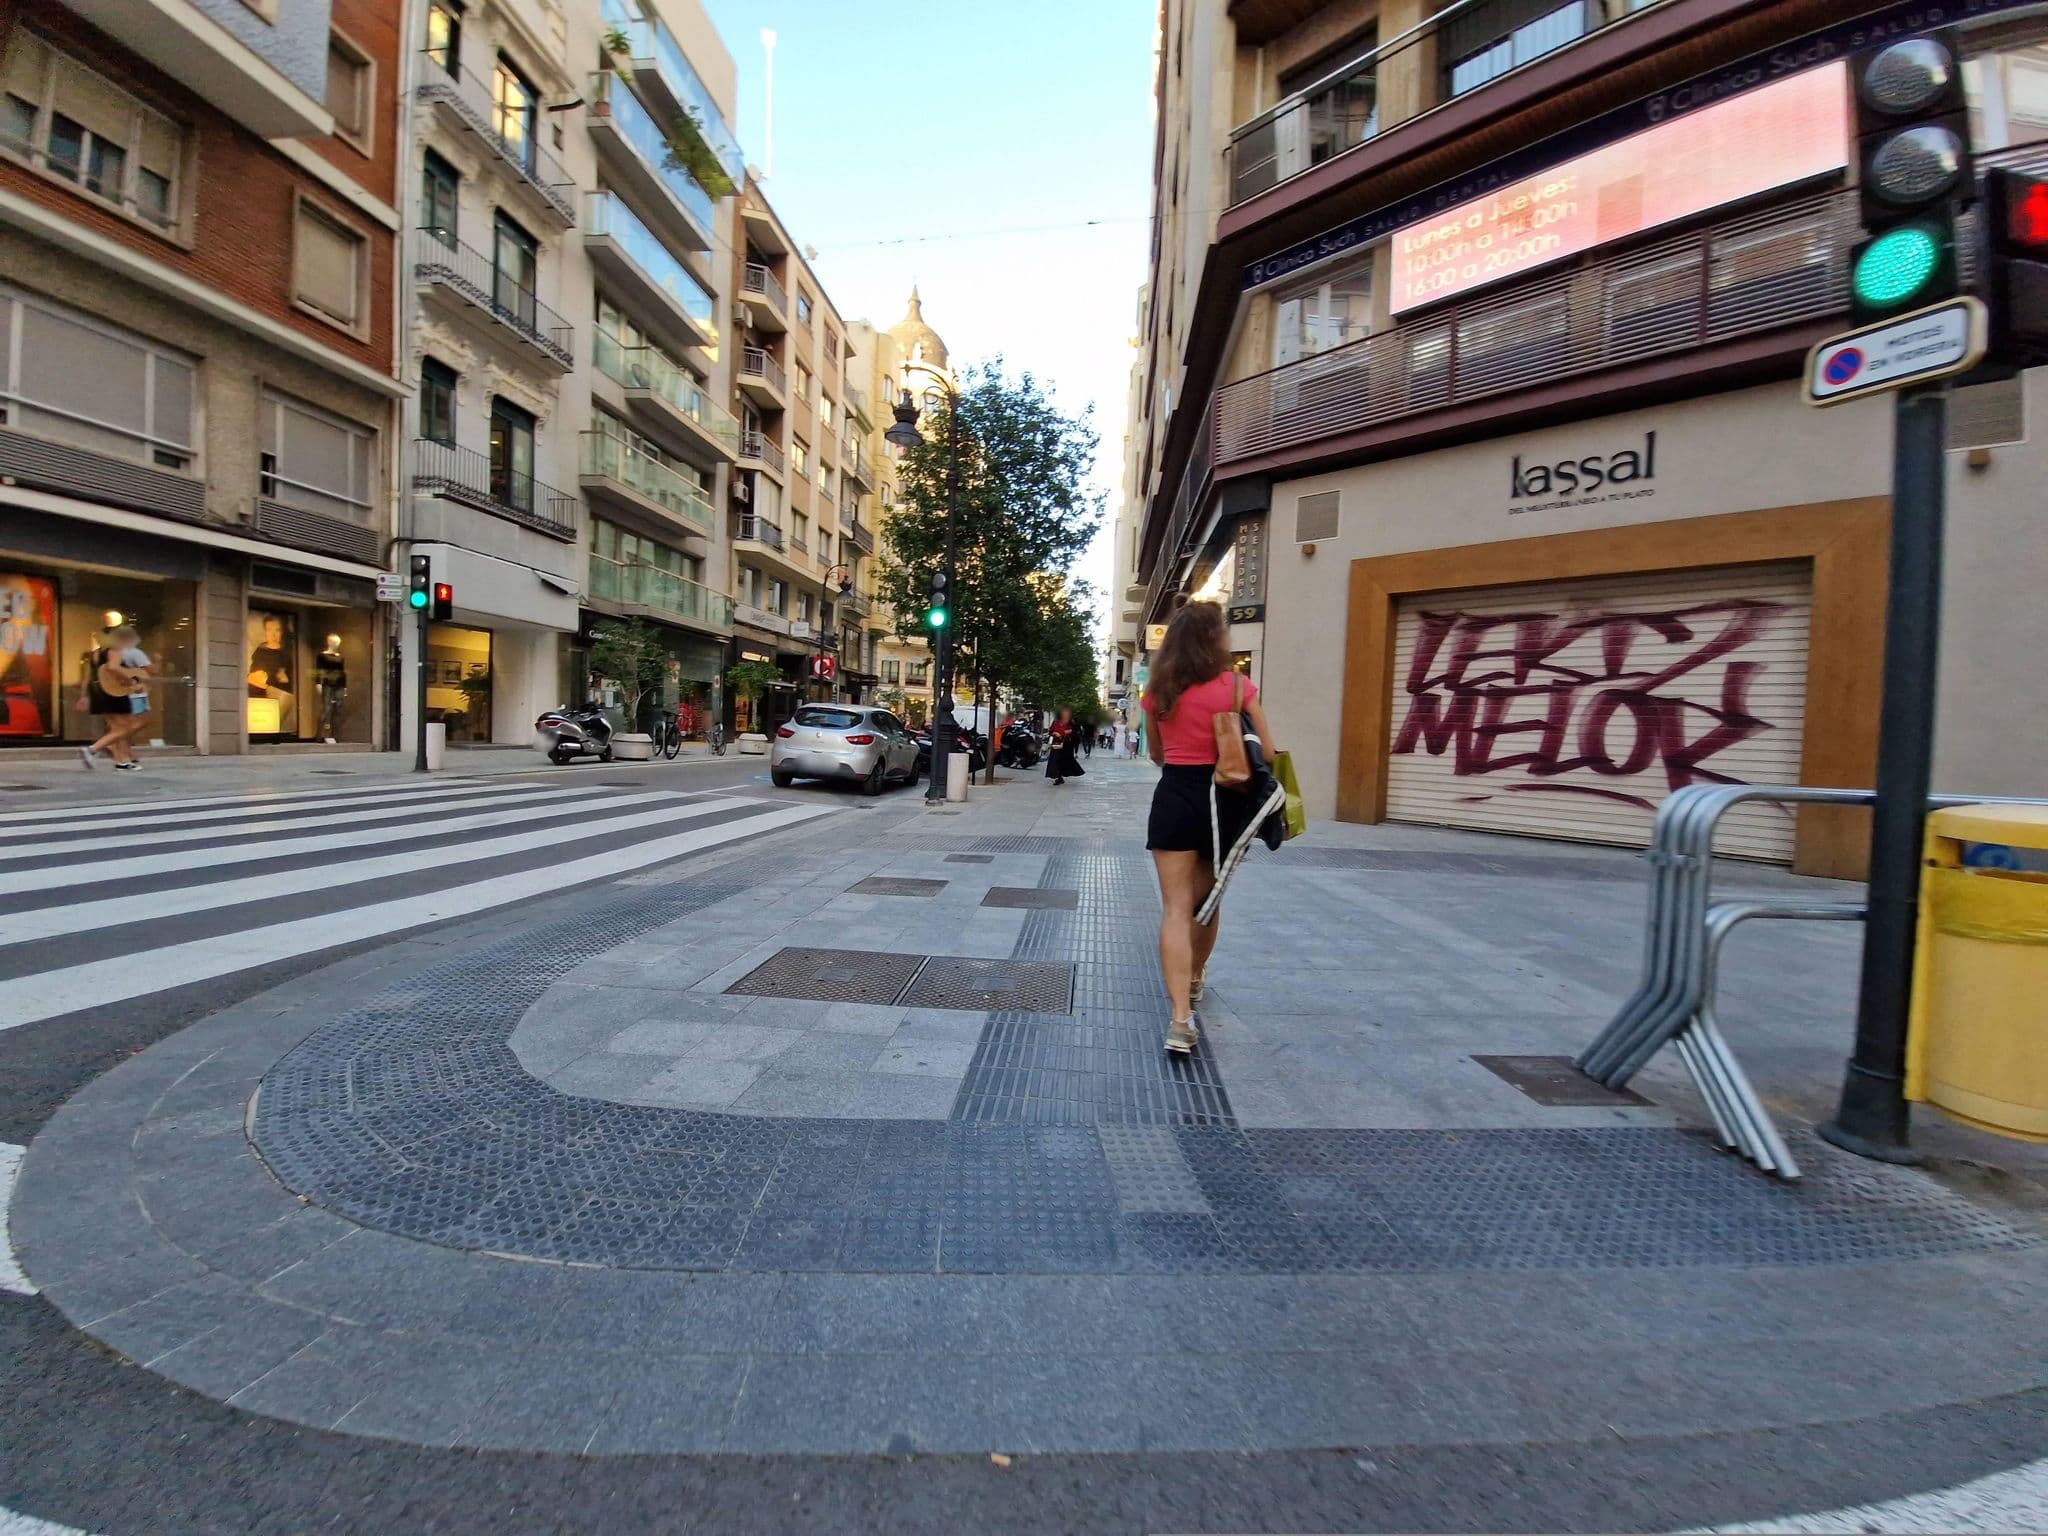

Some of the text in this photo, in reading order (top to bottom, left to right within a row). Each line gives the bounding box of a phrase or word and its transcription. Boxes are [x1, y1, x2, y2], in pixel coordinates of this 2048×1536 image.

[1435, 171, 1511, 208] DENTAL
[1403, 218, 1462, 253] Lunes
[1465, 213, 1483, 230] a
[1406, 233, 1561, 300] 16:00 a 20:00h
[1407, 240, 1472, 276] 10:00h
[1476, 234, 1493, 249] a
[1511, 430, 1656, 498] lassal
[1233, 606, 1257, 621] 59
